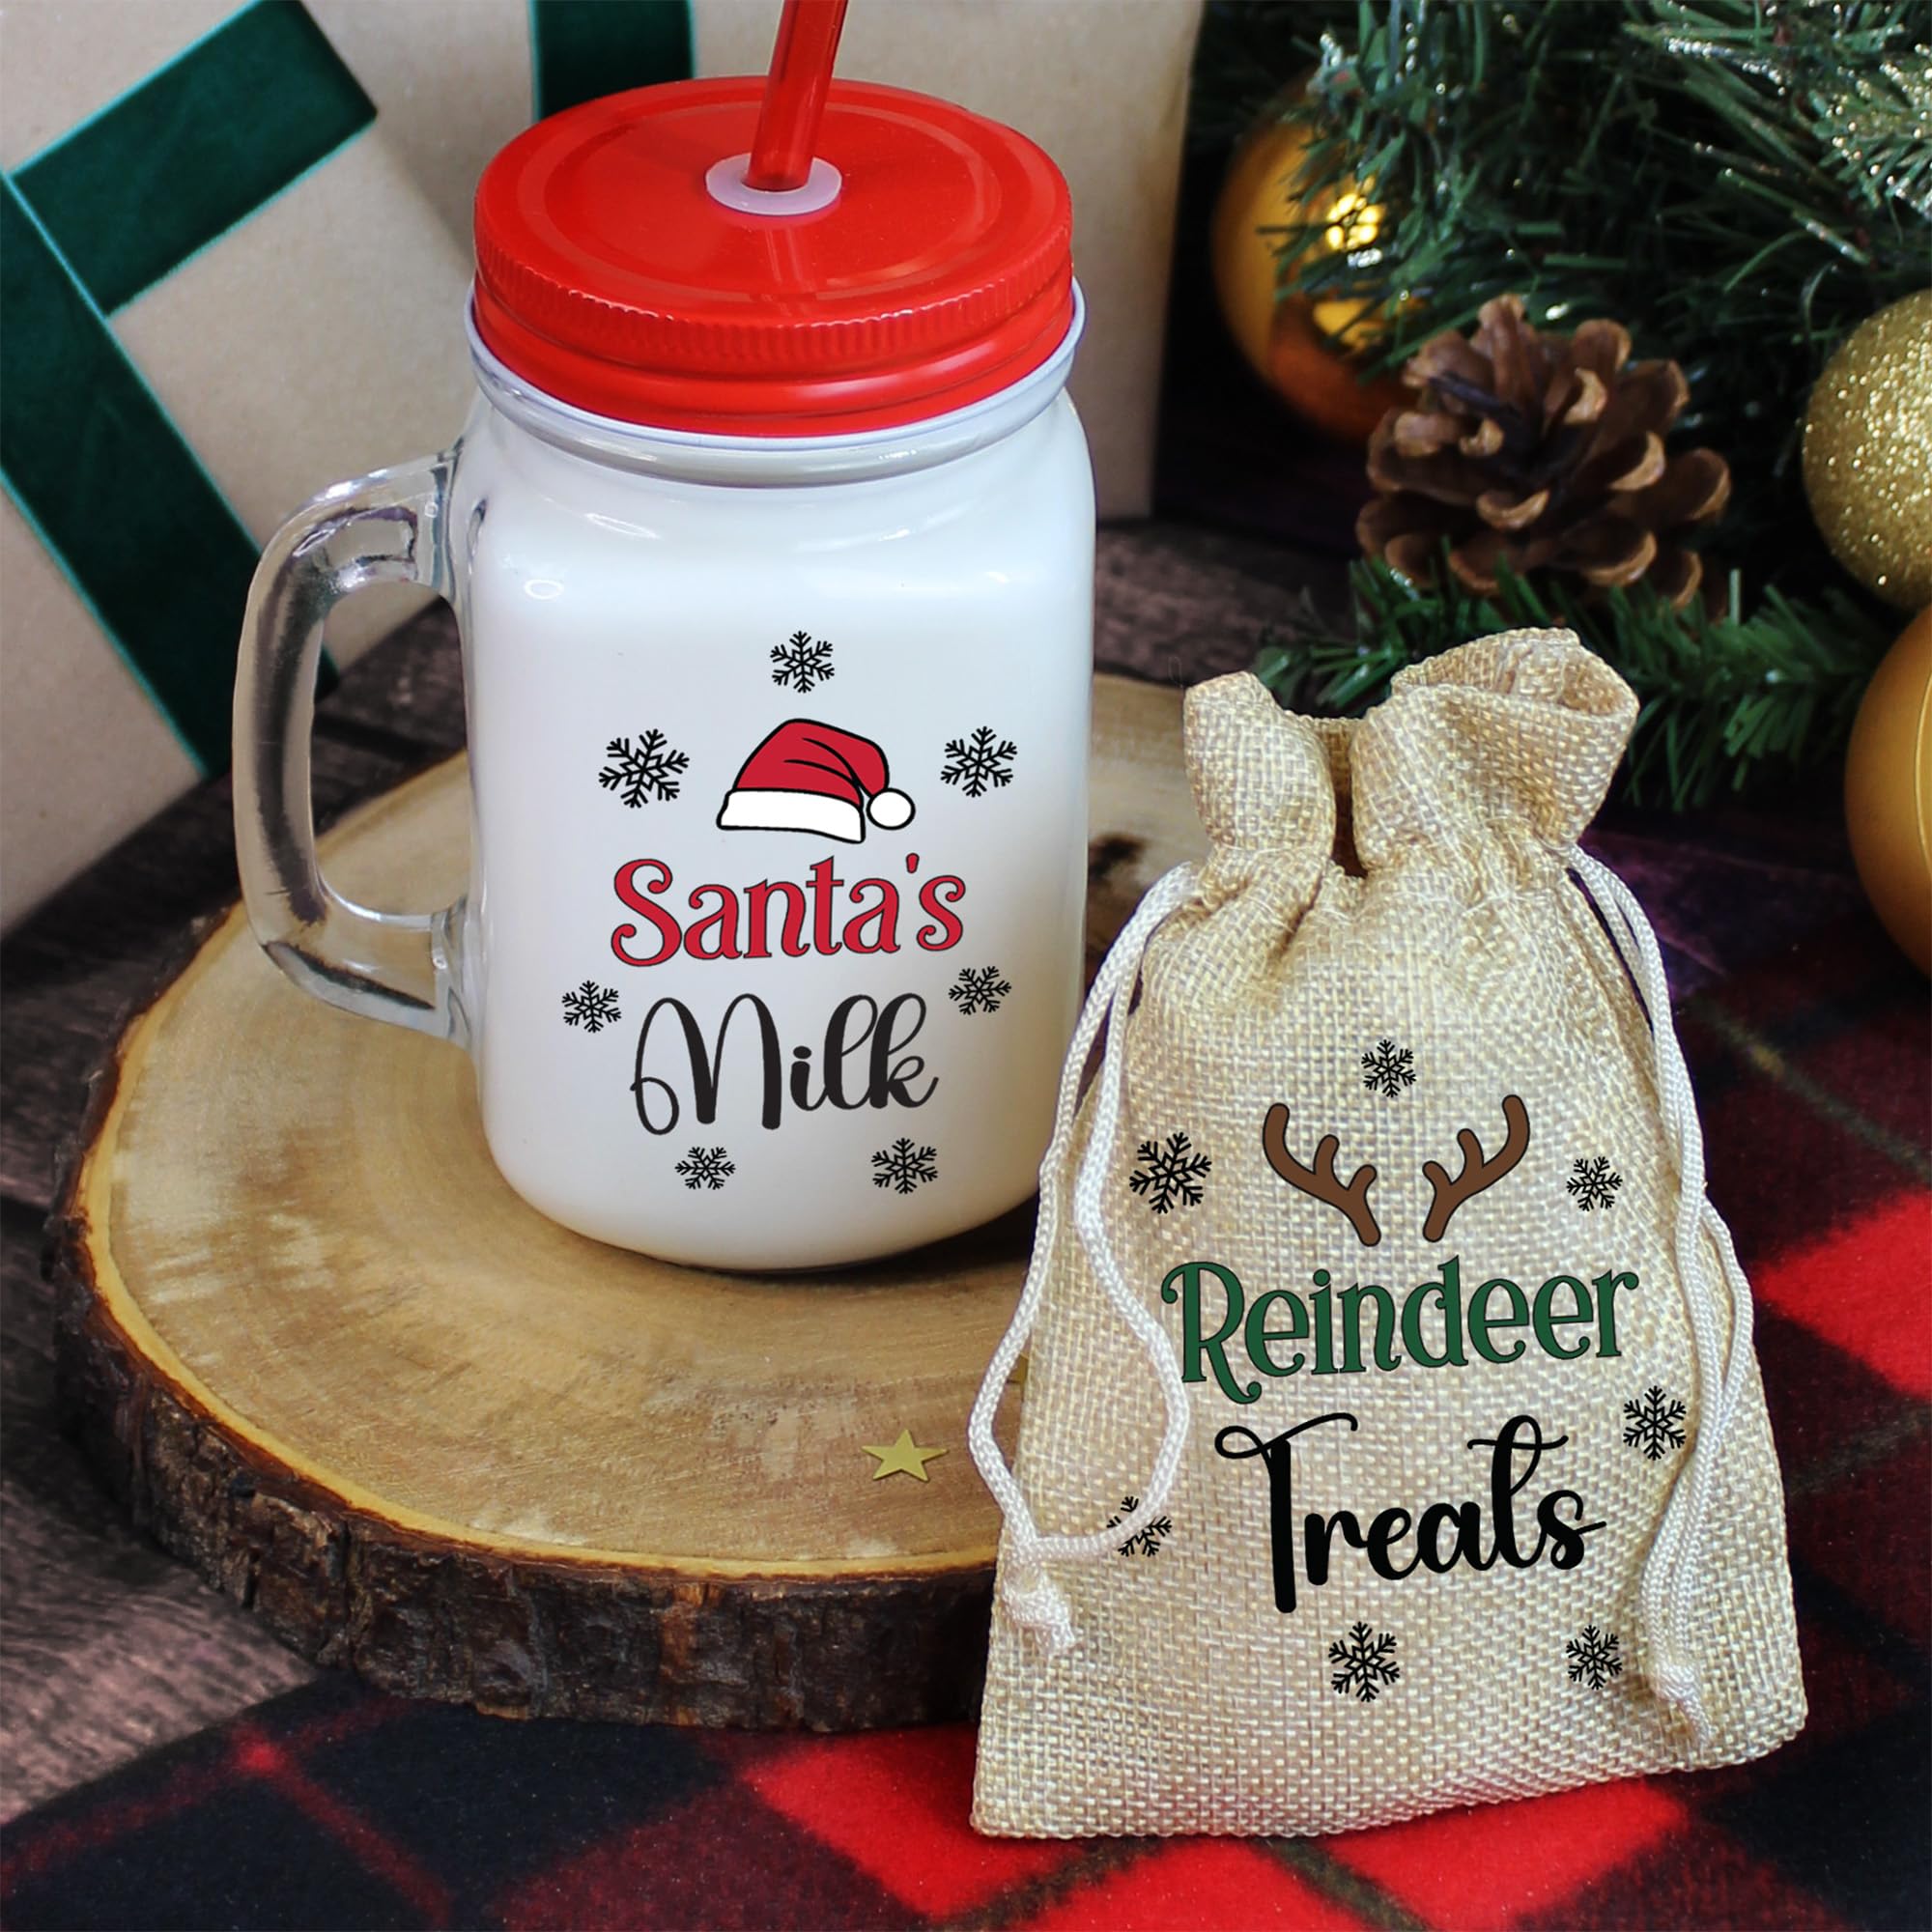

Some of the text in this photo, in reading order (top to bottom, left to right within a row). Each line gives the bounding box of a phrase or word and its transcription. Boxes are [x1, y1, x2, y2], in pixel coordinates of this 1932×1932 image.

[611, 852, 967, 967] Santa's
[630, 993, 939, 1135] Milk
[1161, 1255, 1639, 1405] Reindeer
[1214, 1412, 1606, 1613] Treats
